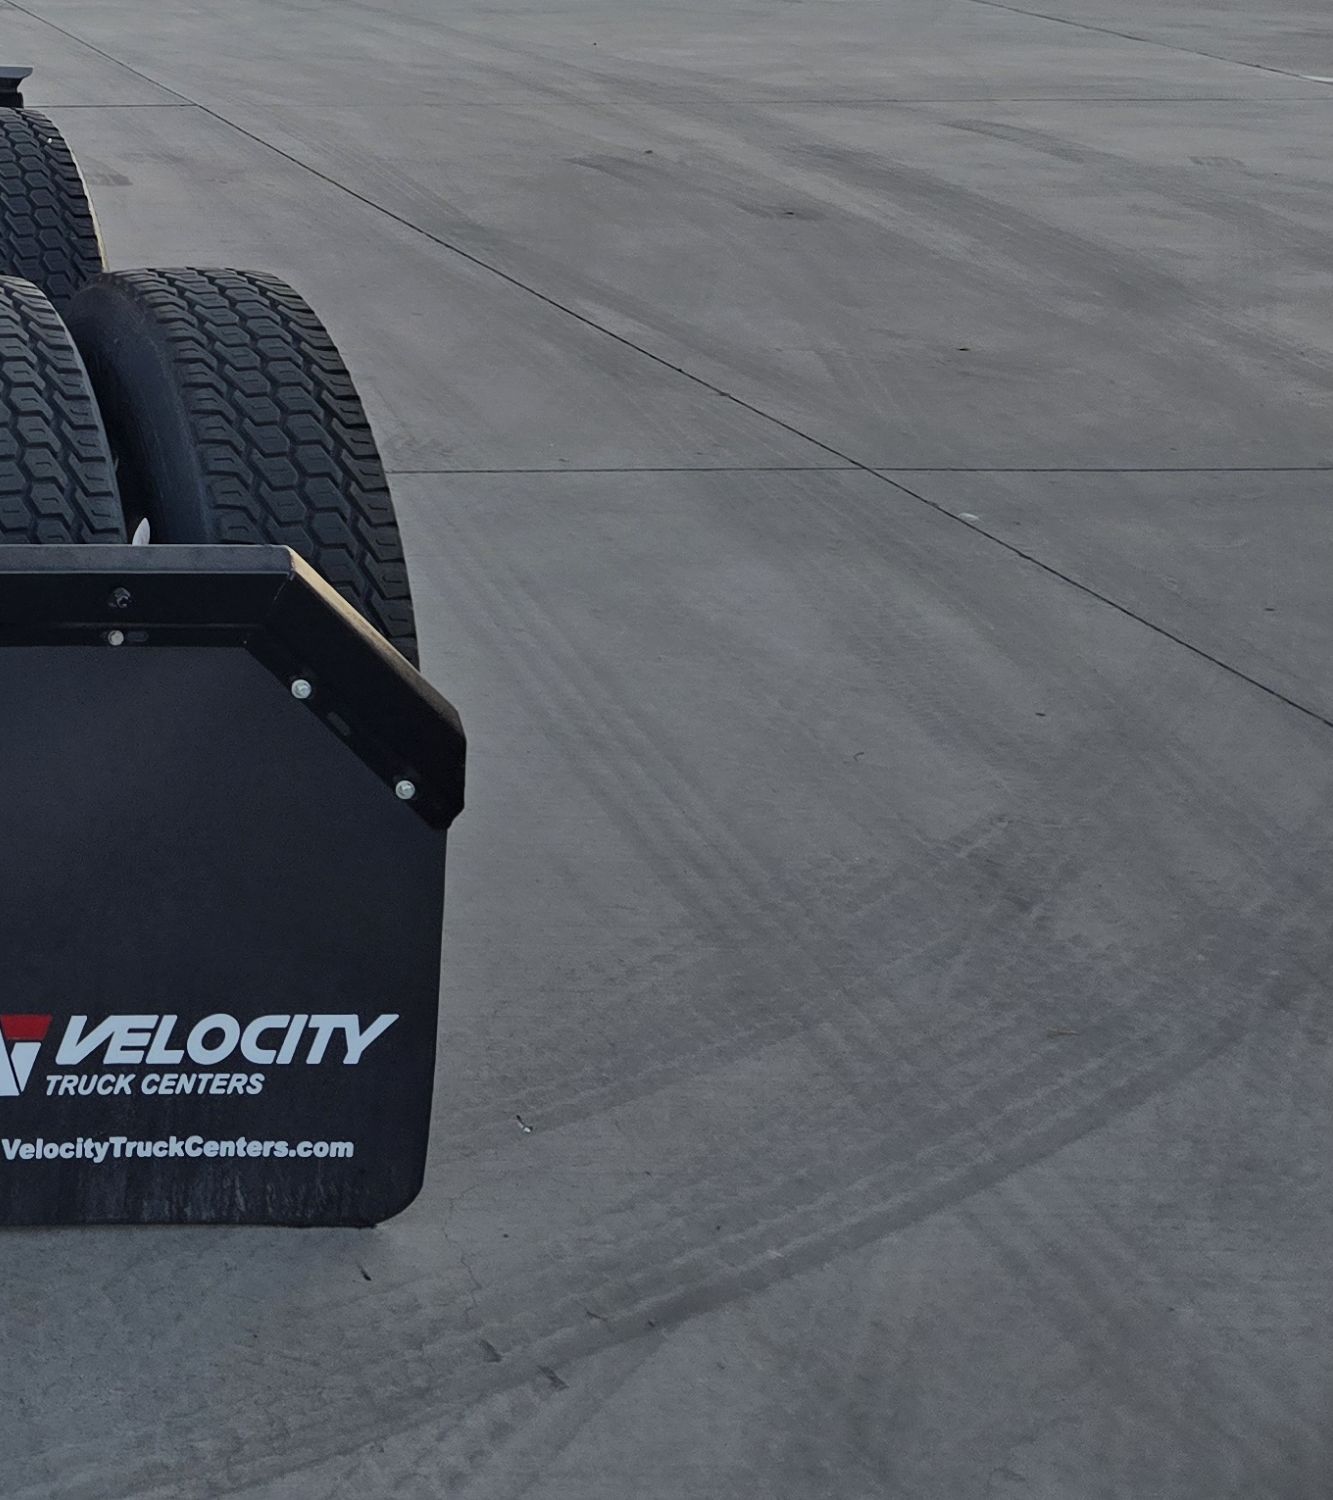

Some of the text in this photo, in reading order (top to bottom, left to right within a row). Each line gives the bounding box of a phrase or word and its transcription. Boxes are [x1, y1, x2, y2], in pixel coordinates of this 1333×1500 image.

[55, 1013, 400, 1066] VELOCITY
[45, 1073, 266, 1097] TRUCK CENTERS
[1, 1135, 355, 1164] VelocityTruckCenters.com
